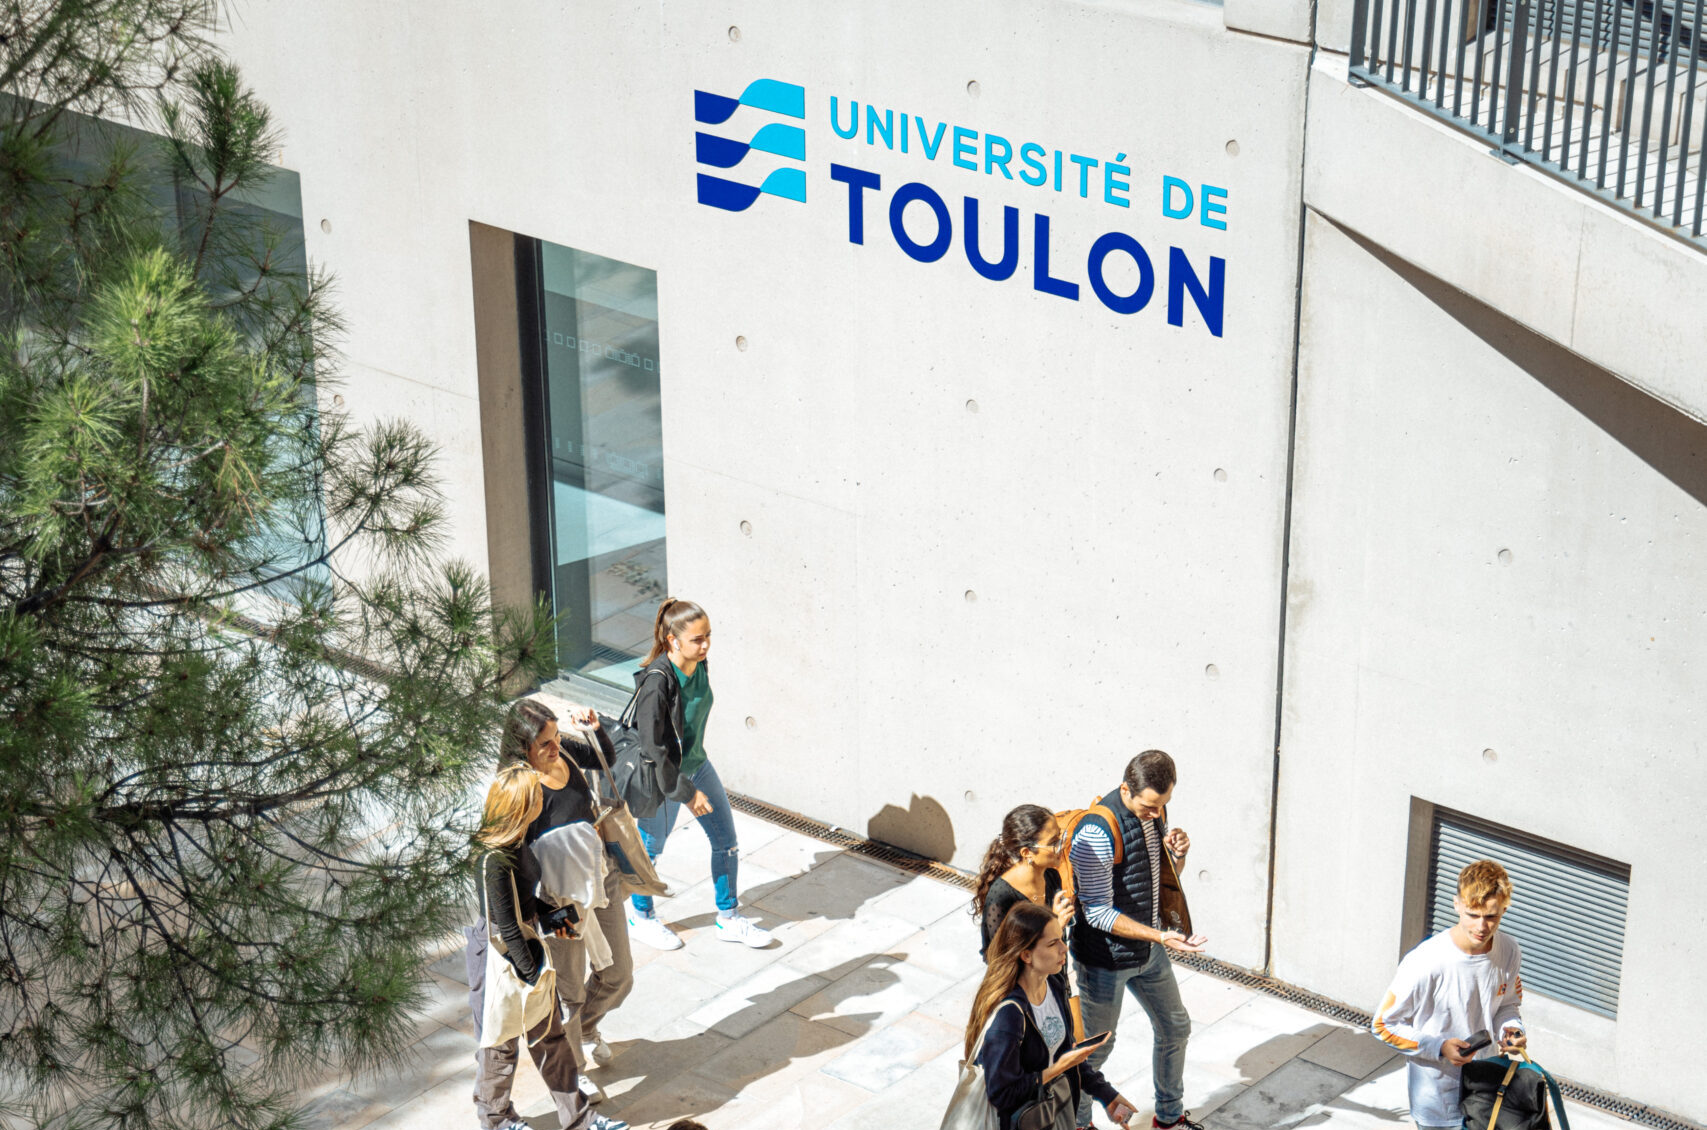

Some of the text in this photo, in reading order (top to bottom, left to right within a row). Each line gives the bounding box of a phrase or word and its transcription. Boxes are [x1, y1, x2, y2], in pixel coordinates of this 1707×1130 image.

[830, 96, 1228, 231] UNIVERSITÉ DE
[830, 163, 1226, 338] TOULON
